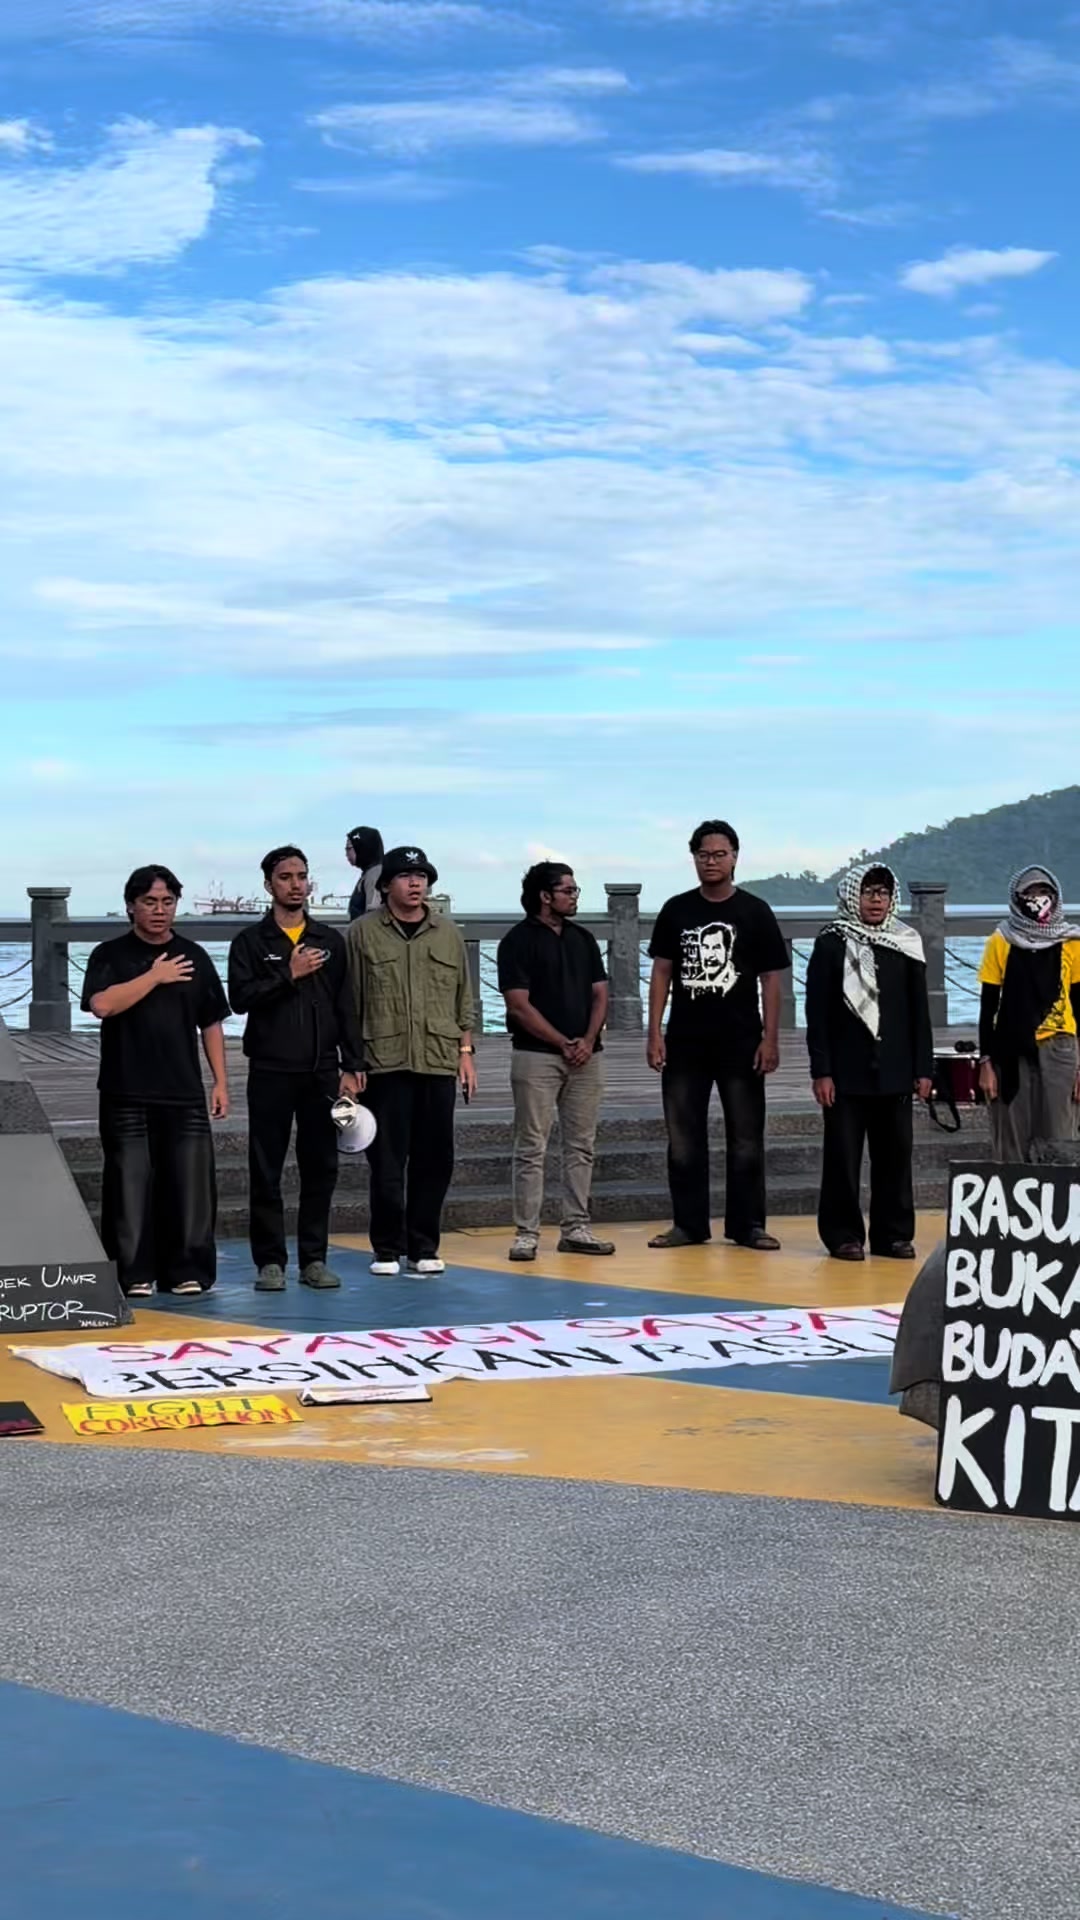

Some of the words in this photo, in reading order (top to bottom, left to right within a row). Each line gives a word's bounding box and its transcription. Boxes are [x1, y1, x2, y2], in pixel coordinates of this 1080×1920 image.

[98, 1322, 545, 1363] SAYANGI
[942, 1320, 1080, 1393] BUDA
[80, 1407, 294, 1432] CORRUPTION
[86, 1398, 256, 1419] FIGHT
[938, 1395, 1080, 1512] KIT
